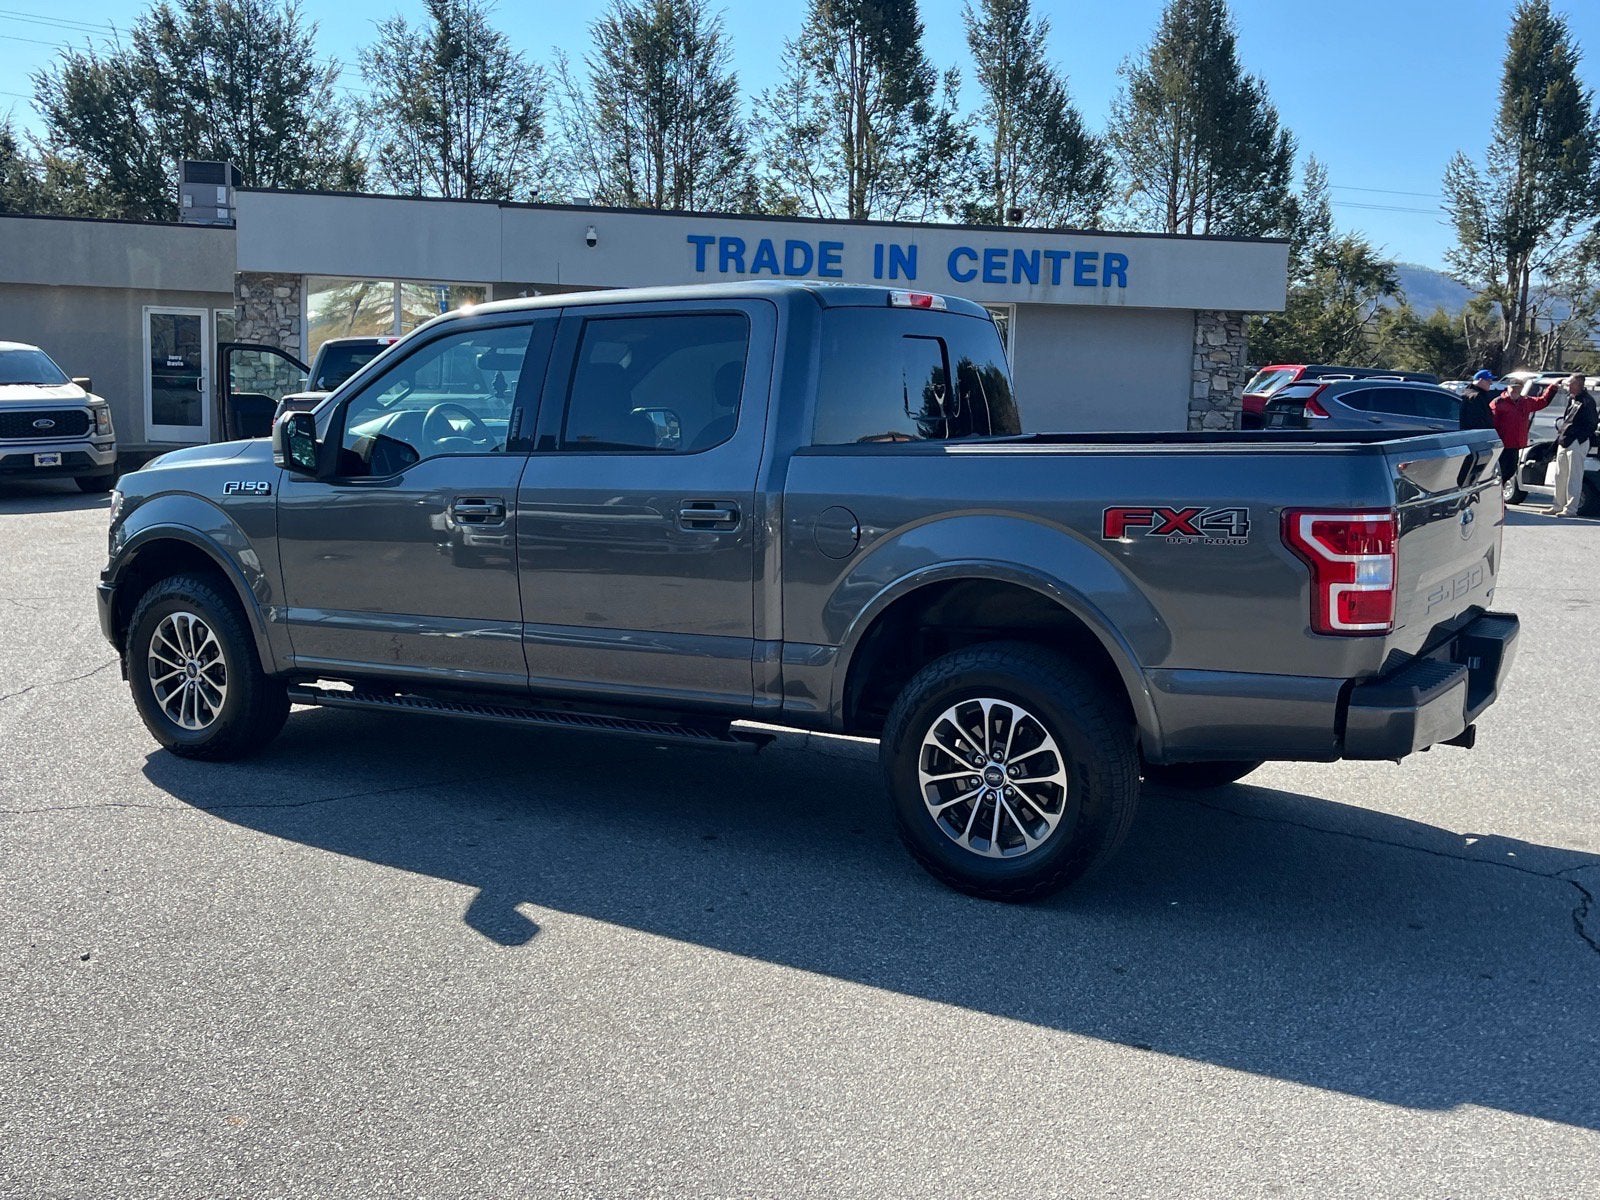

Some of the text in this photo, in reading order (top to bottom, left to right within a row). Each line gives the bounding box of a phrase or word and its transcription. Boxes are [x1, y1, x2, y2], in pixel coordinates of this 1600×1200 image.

[687, 235, 1129, 287] TRADE IN CENTER
[1102, 505, 1250, 540] FX4
[1166, 537, 1249, 545] OFF ROAD
